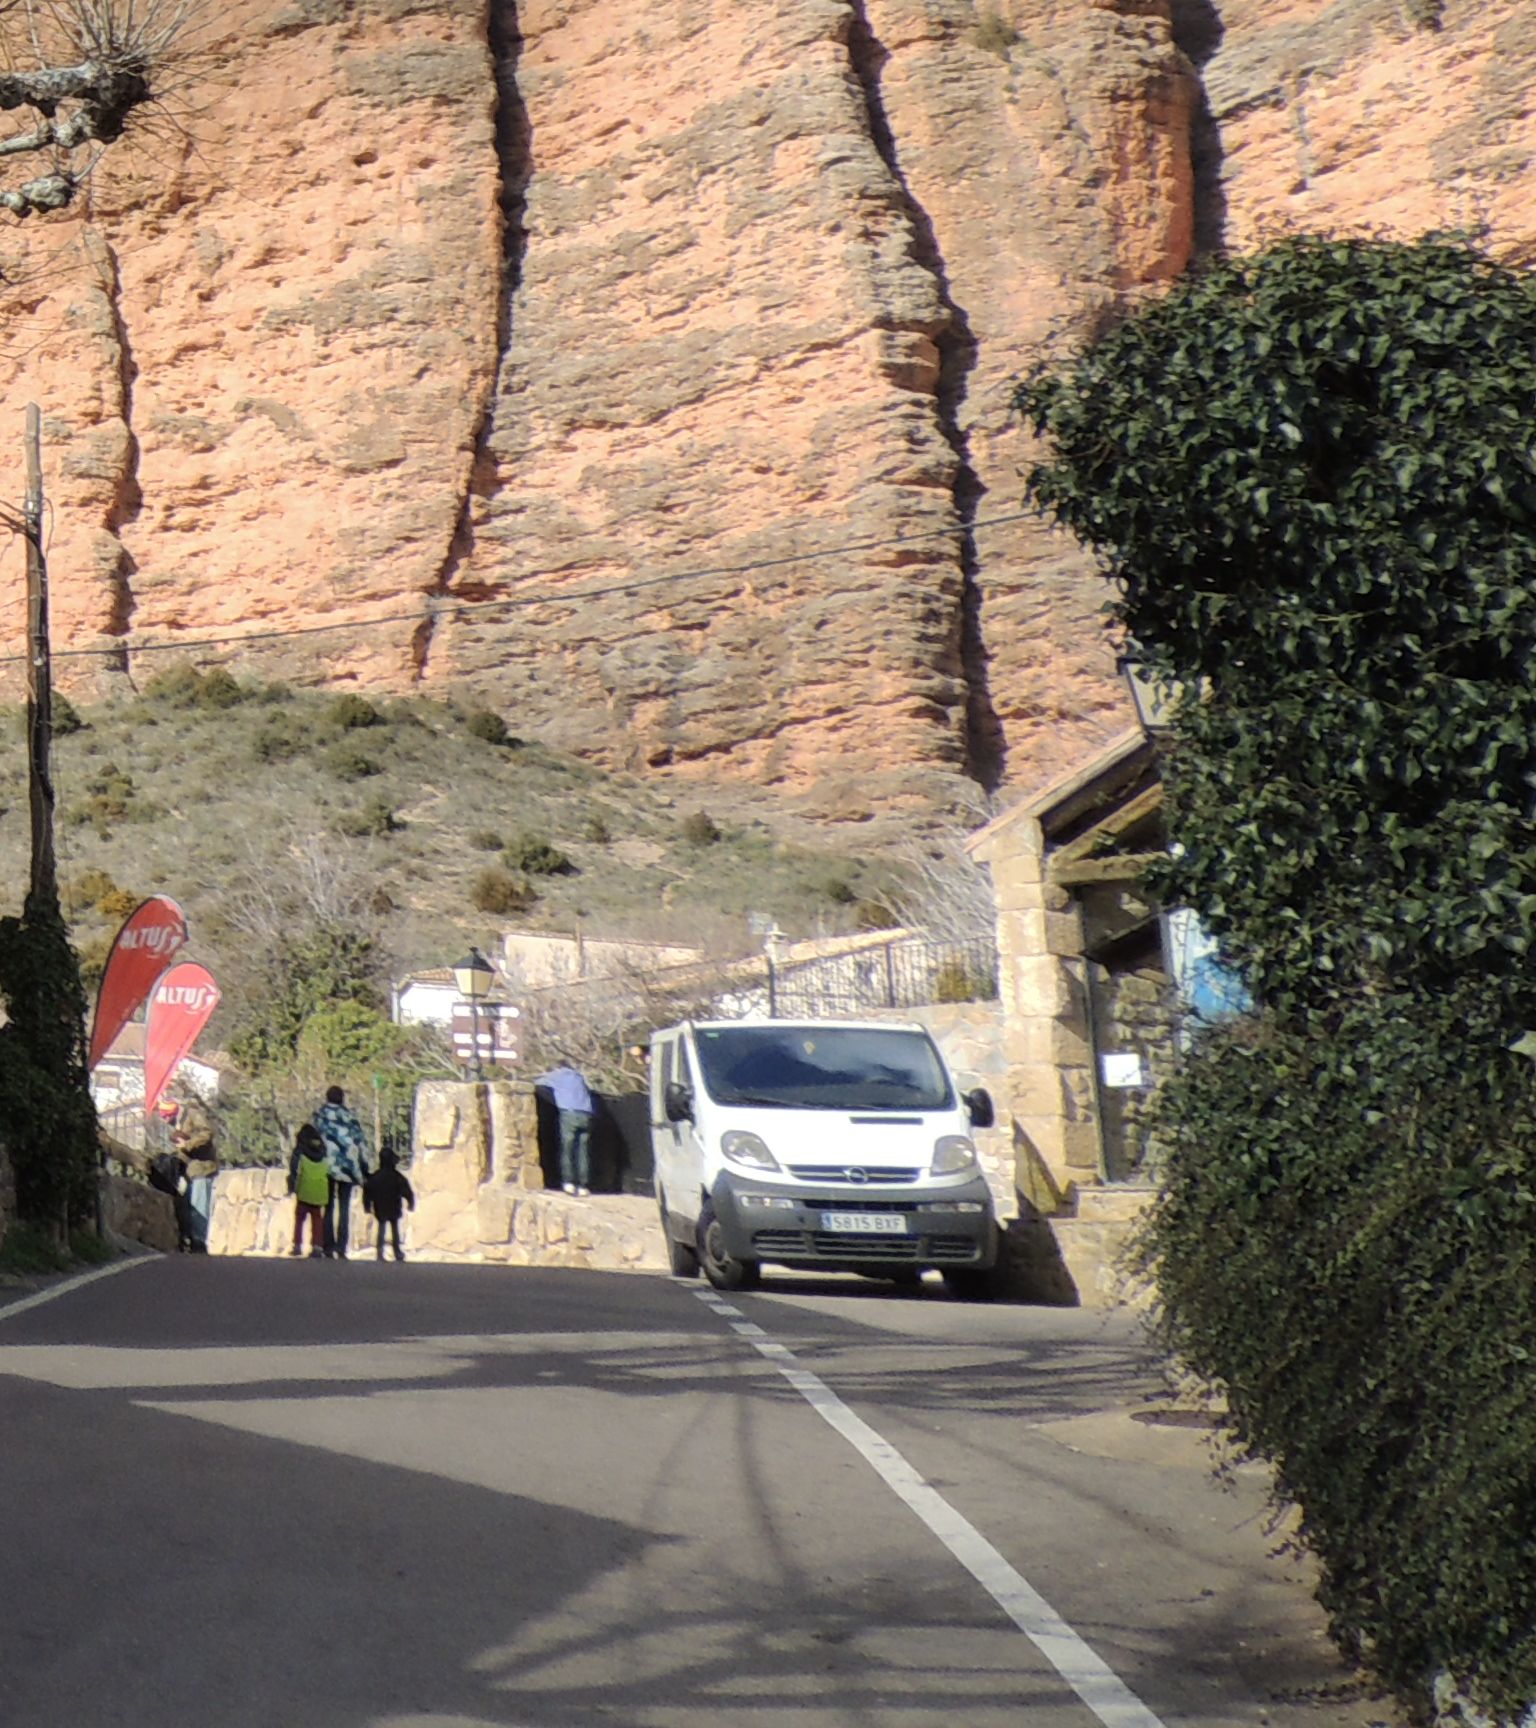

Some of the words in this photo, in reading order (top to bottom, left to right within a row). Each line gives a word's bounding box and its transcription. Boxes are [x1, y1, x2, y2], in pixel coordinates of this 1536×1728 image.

[119, 925, 172, 953] ALTUS
[156, 986, 207, 1010] ALTUS
[833, 1215, 871, 1229] 5815
